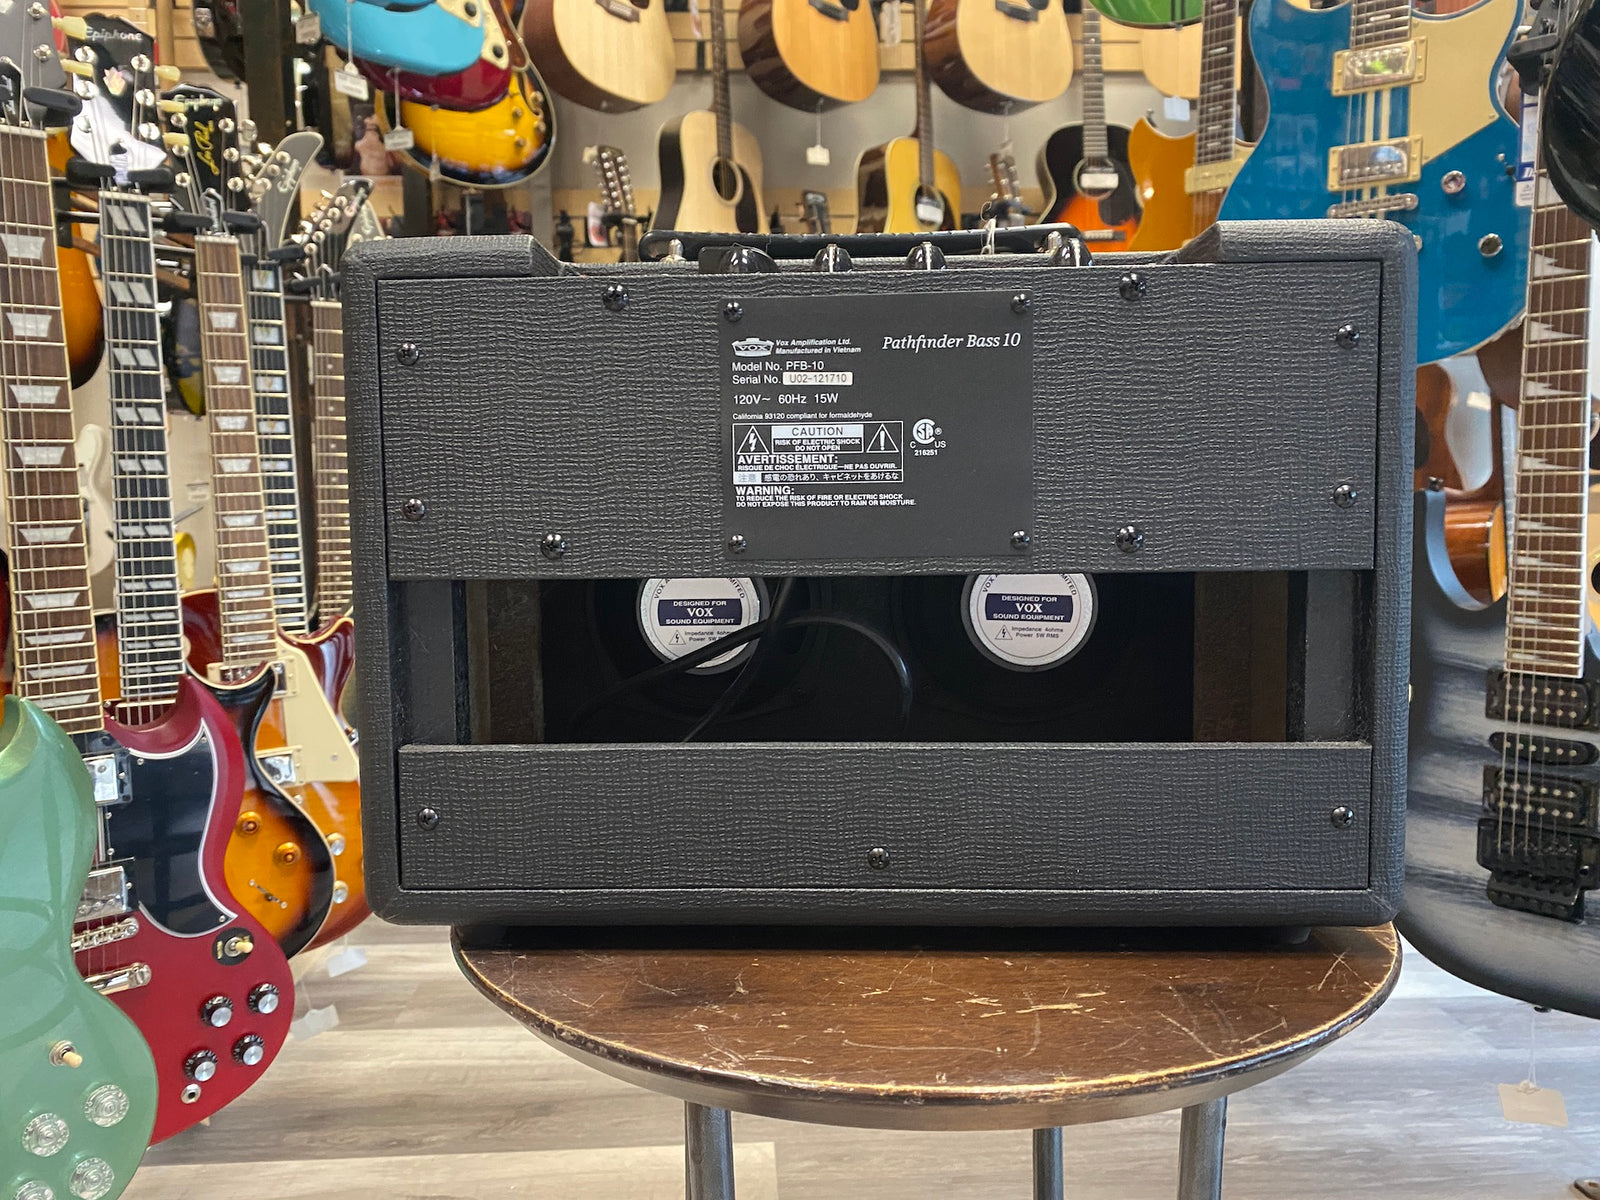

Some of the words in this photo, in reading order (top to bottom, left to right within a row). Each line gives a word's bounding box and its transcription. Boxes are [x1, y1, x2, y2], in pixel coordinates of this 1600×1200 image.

[790, 338, 836, 347] Amplification
[882, 334, 964, 354] Pathfinder
[966, 334, 1000, 348] Bass
[1003, 332, 1021, 347] 10
[732, 362, 762, 372] Model
[766, 362, 783, 370] No.
[786, 360, 824, 370] PFB-10
[732, 374, 761, 384] Serial
[764, 374, 781, 384] No.
[789, 374, 847, 383] U02-121710
[778, 394, 807, 404] 60Hz
[814, 393, 839, 404] 15W
[786, 412, 817, 420] compliant
[792, 427, 844, 436] CAUTION
[738, 454, 838, 464] AVERTISSEMENT:
[736, 486, 795, 495] WARNING:
[982, 578, 995, 593] VOX
[654, 584, 666, 599] VOX
[687, 608, 714, 617] VOX
[1016, 603, 1043, 613] VOX
